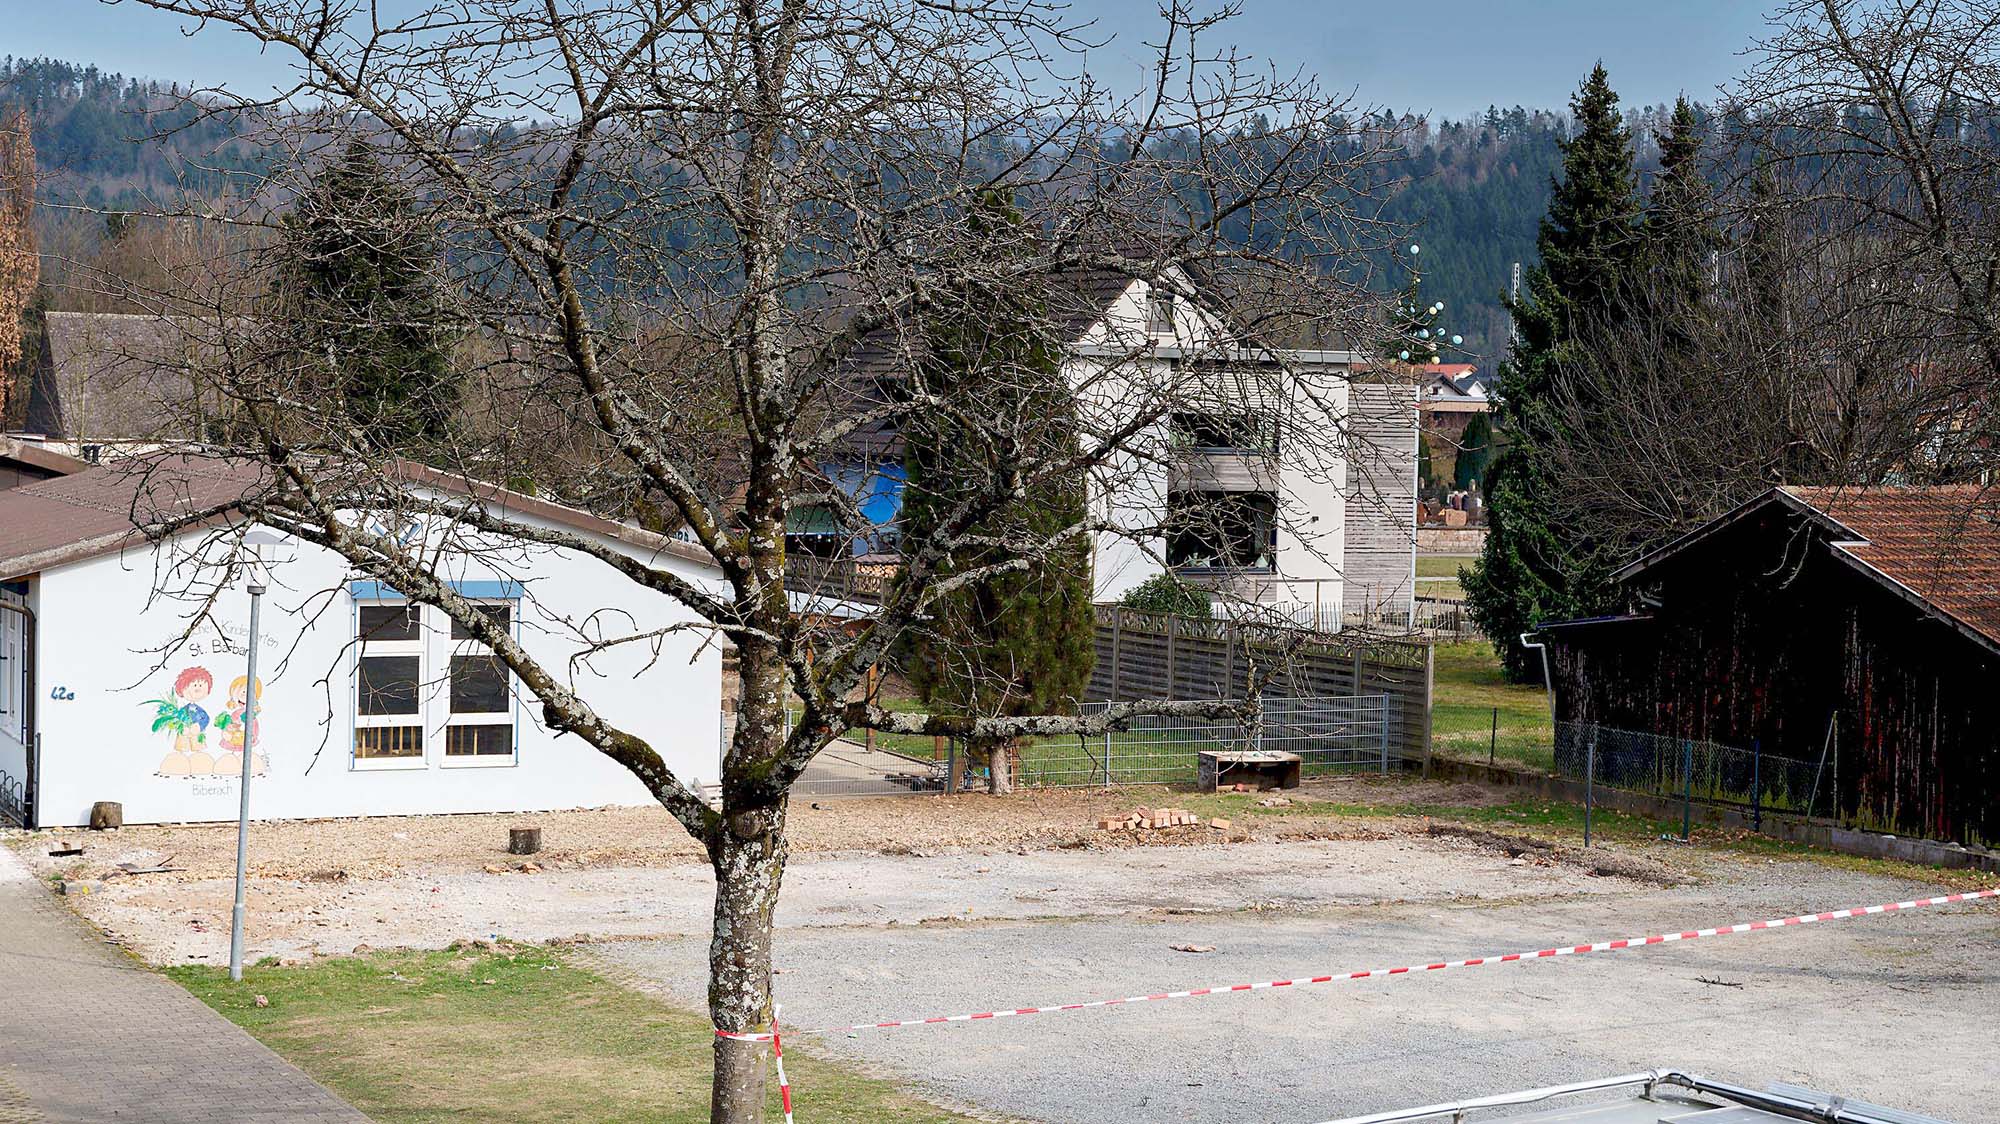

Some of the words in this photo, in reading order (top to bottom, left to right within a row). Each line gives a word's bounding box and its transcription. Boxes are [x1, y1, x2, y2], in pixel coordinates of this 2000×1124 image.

[188, 642, 207, 657] St.
[212, 639, 249, 657] Barbar
[51, 686, 75, 700] 42a
[192, 783, 233, 796] Biberach
